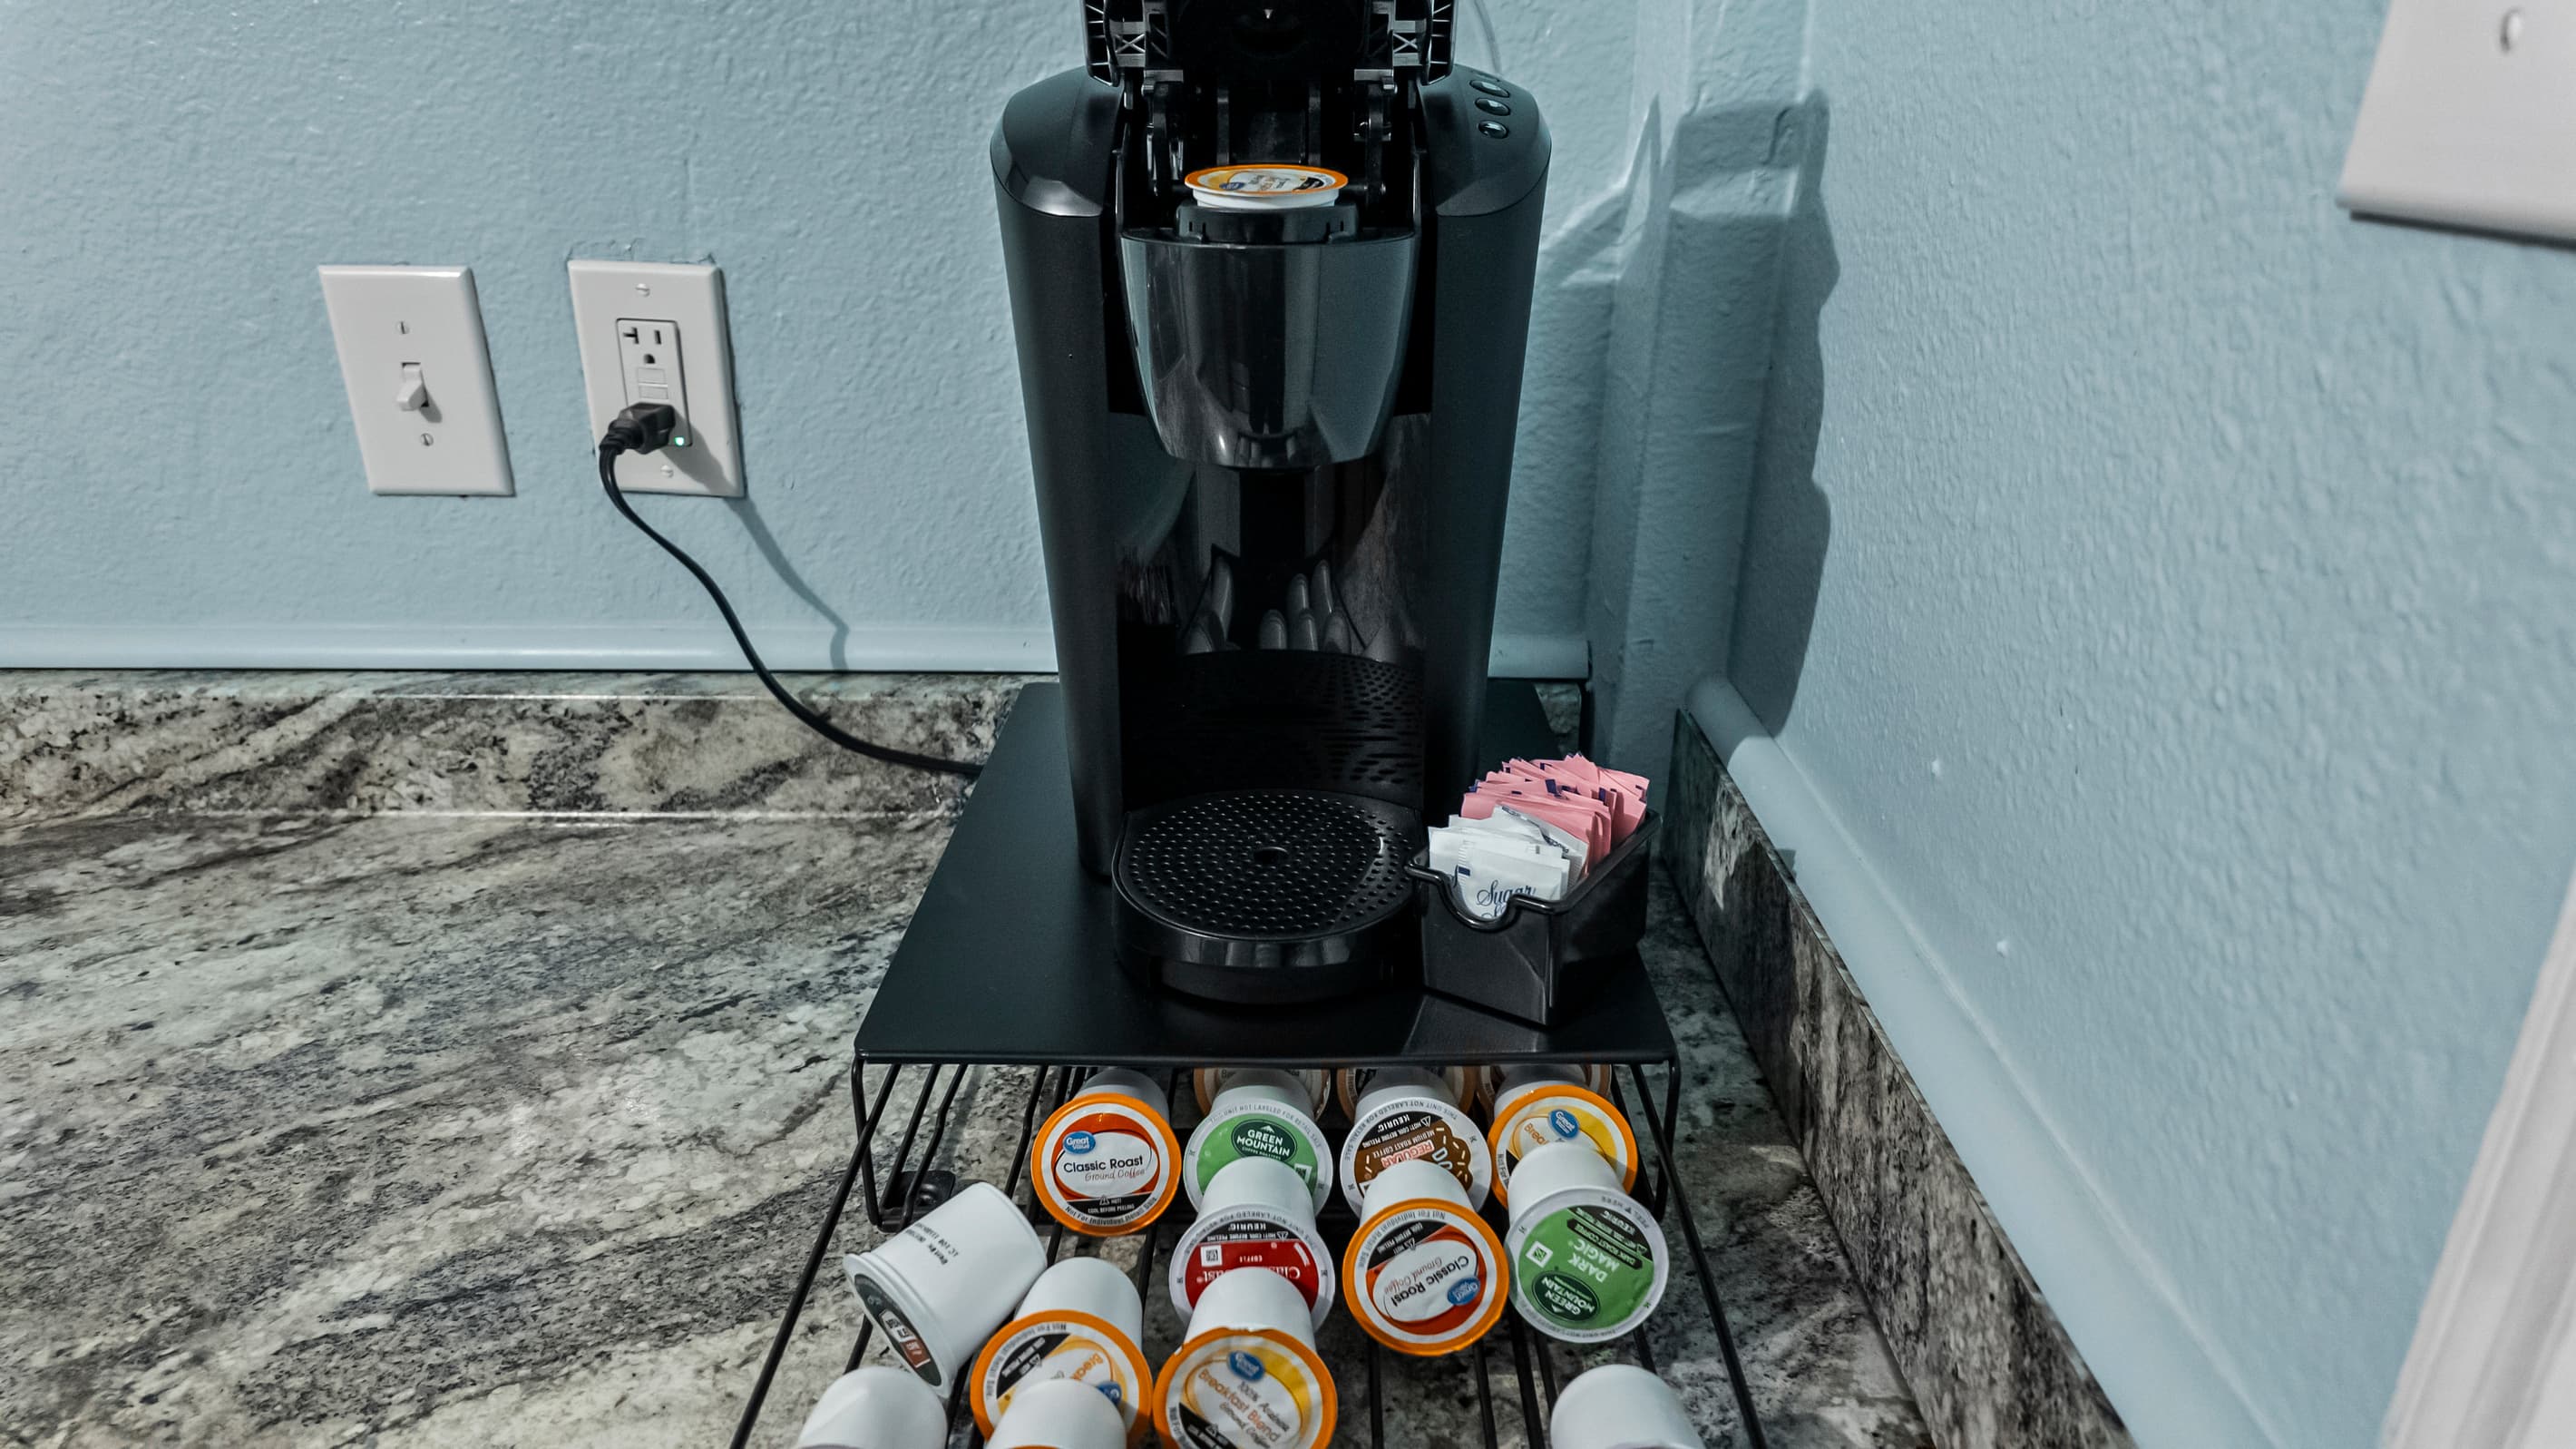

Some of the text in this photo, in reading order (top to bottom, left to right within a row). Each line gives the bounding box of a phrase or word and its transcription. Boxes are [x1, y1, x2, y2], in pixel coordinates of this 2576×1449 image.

[1066, 1136, 1090, 1146] Great
[1236, 1135, 1290, 1157] MOUNTAIN
[1247, 1129, 1283, 1146] GREEN
[1372, 1130, 1435, 1158] MEDIUM ROAST COFFEE
[1063, 1156, 1143, 1173] Classic Roast
[1381, 1140, 1434, 1168] REGULAR
[1085, 1169, 1146, 1182] Ground Coffee
[1065, 1205, 1077, 1217] Not
[1089, 1217, 1125, 1226] Individual
[1117, 1203, 1135, 1211] PEELING
[1432, 1210, 1446, 1219] Not
[1381, 1210, 1417, 1234] Individual
[1573, 1238, 1620, 1271] MAGIC
[1575, 1223, 1636, 1265] DARK ROAST COFFEE
[1384, 1258, 1443, 1296] Ground Coffee
[1426, 1256, 1469, 1286] Classic
[1567, 1252, 1608, 1283] DARK
[1390, 1281, 1426, 1307] Roast
[1541, 1277, 1595, 1314] MOUNTAIN
[1545, 1290, 1581, 1316] GREEN
[1199, 1368, 1250, 1413] Breakfast
[1248, 1409, 1281, 1443] Blend
